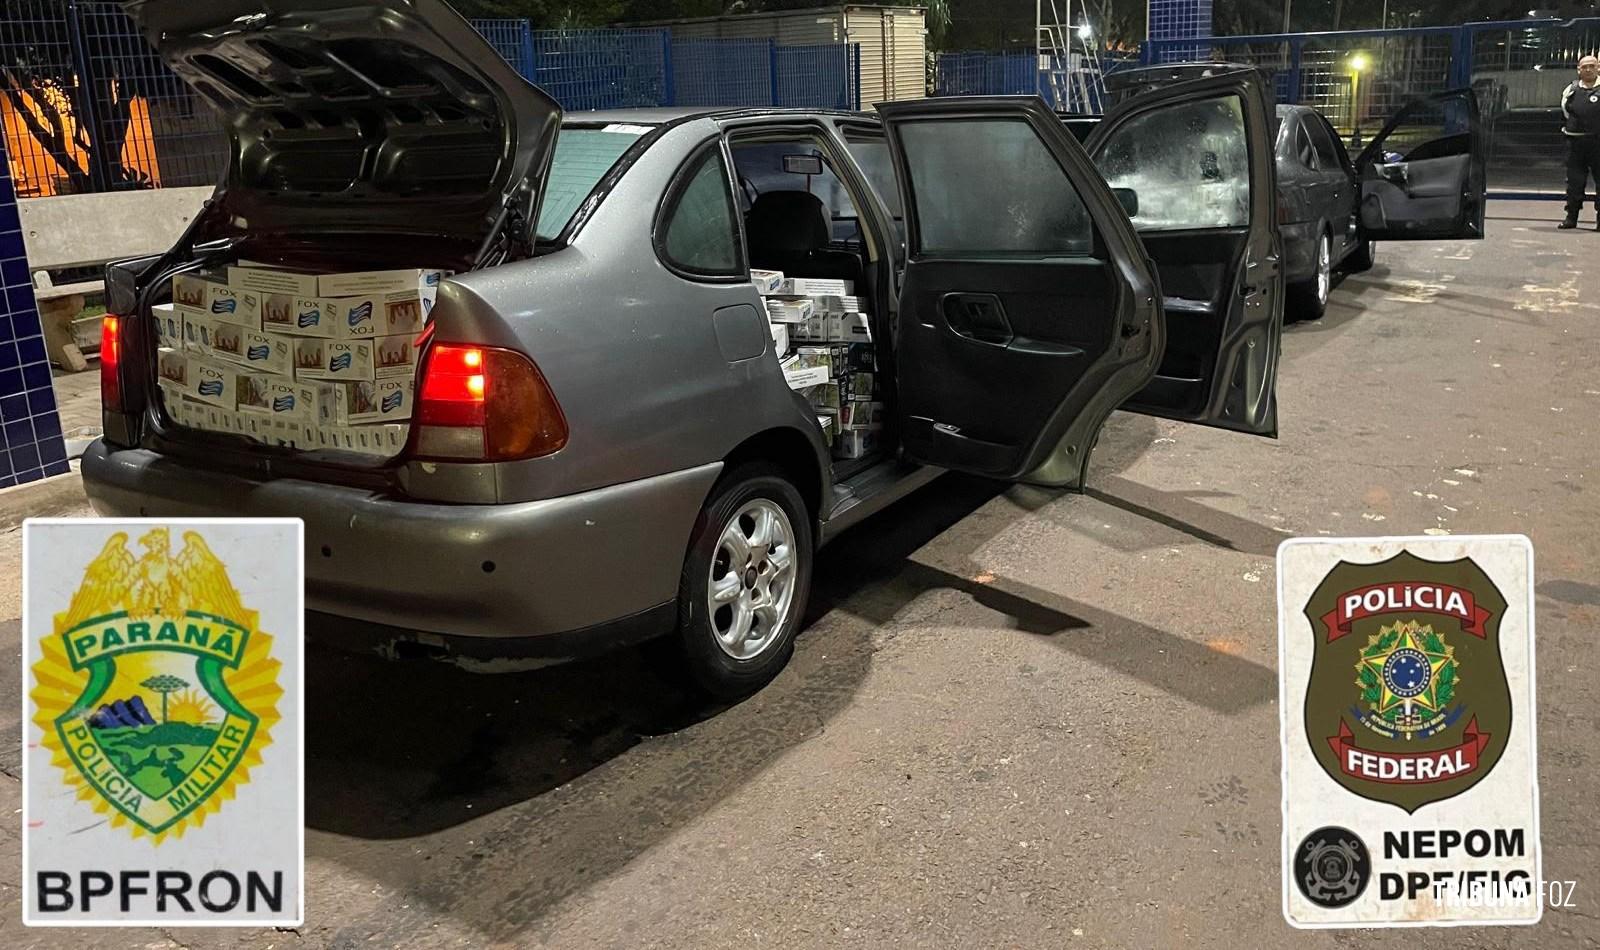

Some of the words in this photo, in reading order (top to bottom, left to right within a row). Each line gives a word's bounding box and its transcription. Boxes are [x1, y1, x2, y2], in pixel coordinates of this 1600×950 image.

[212, 287, 236, 298] FOX
[298, 299, 320, 309] FOX
[247, 333, 271, 345] FOX
[329, 342, 352, 352] FOX
[199, 366, 225, 380] FOX
[271, 384, 295, 394] FOX
[380, 381, 403, 390] FOX
